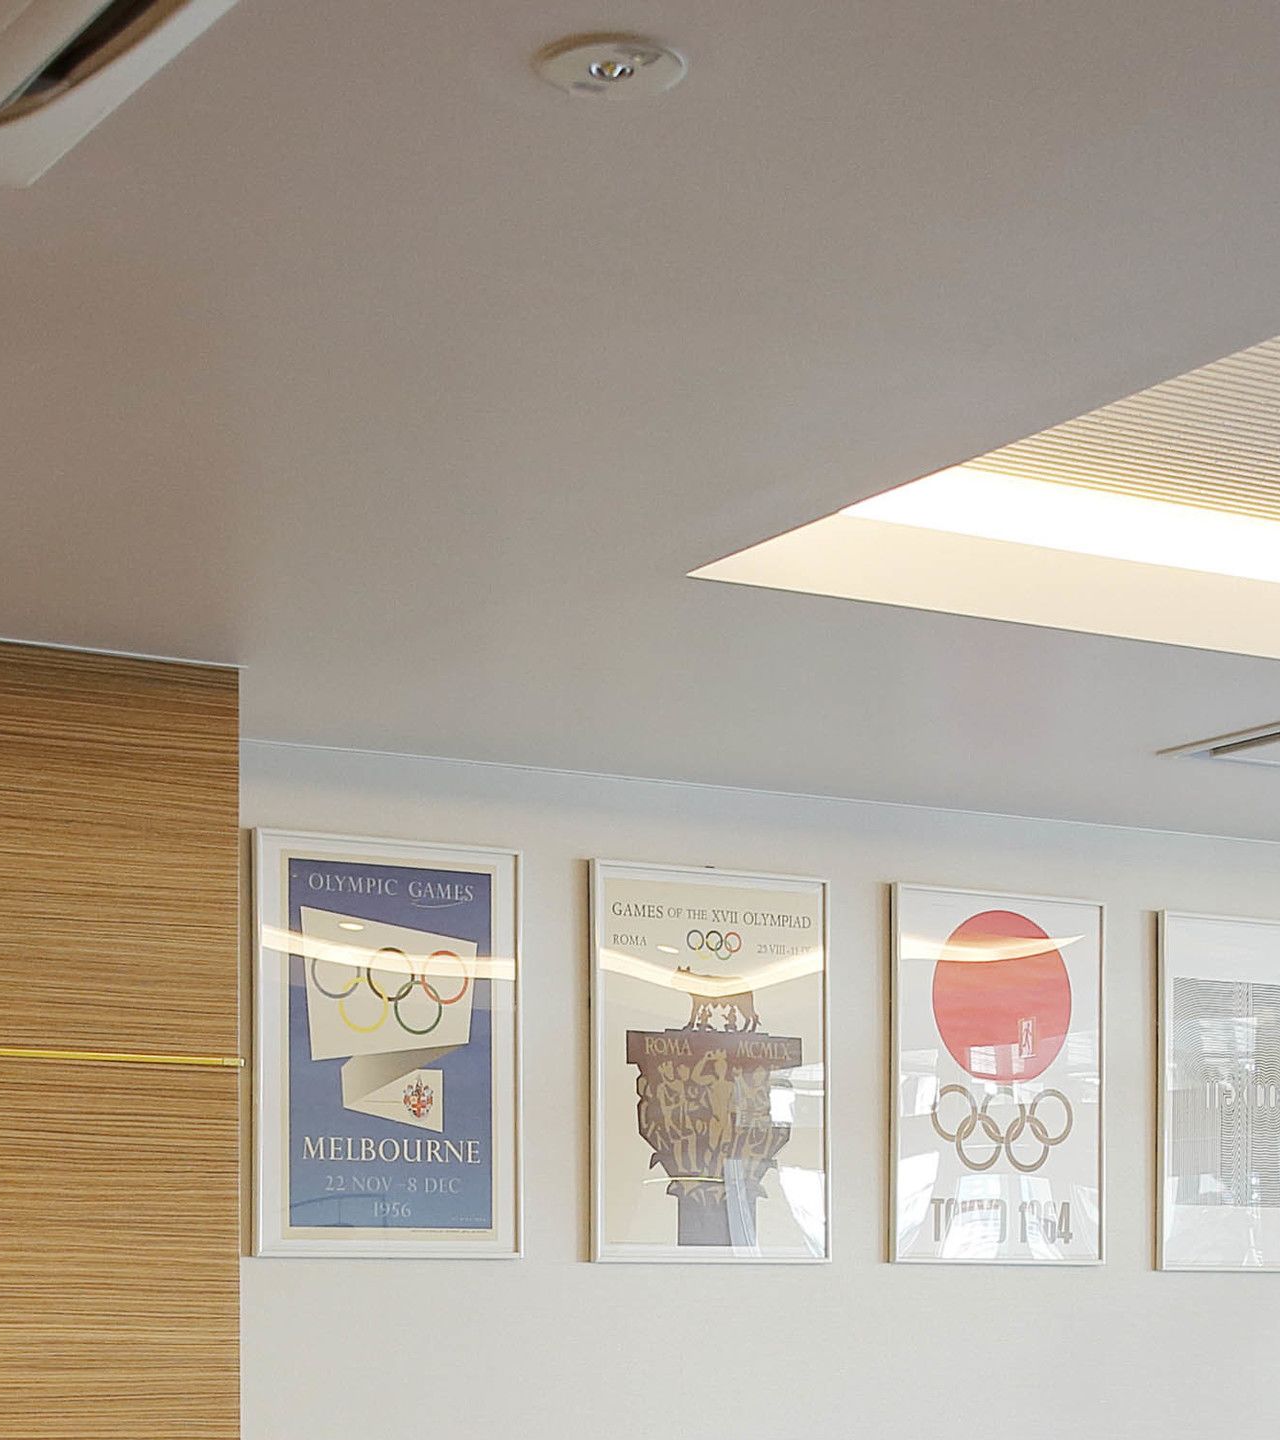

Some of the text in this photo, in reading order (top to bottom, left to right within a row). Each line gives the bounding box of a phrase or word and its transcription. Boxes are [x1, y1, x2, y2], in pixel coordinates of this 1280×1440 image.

[308, 872, 473, 902] OLYMPIC GAMES
[611, 901, 812, 929] GAMES OF THE XVII OLYMPIAD
[613, 933, 648, 947] ROMA
[644, 1036, 793, 1061] ROMA MCMLX
[302, 1136, 481, 1164] MELBOURNE
[324, 1175, 346, 1192] 22
[351, 1176, 393, 1193] NOV
[424, 1177, 461, 1194] DEC
[373, 1201, 412, 1218] 1956
